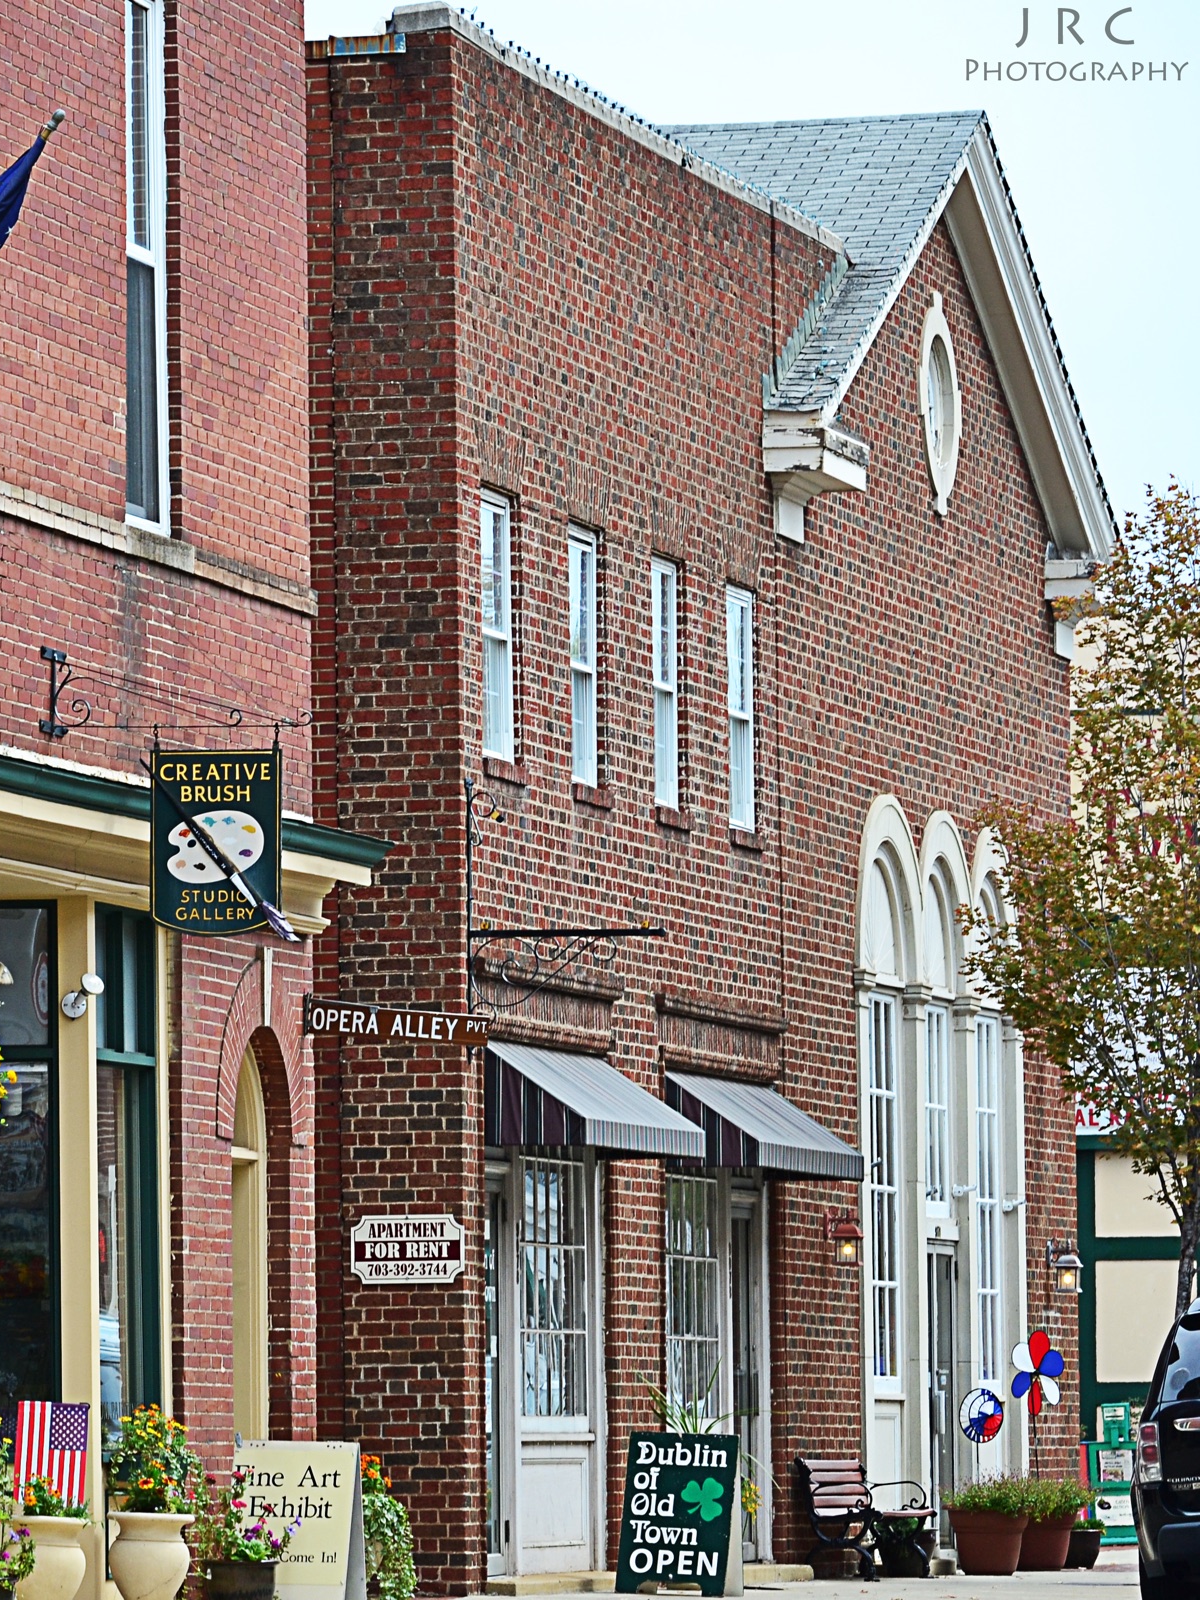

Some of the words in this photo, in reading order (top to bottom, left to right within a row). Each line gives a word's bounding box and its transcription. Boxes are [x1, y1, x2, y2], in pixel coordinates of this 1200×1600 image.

[159, 762, 271, 782] CREATIVE
[179, 784, 251, 803] BRUSH
[180, 889, 249, 904] STUDIO
[175, 906, 255, 922] GALLERY
[311, 1007, 379, 1035] OPERA
[390, 1013, 459, 1041] ALLEY
[368, 1222, 447, 1239] APARTMENT
[364, 1242, 400, 1259] FOR
[405, 1241, 451, 1258] RENT
[367, 1262, 448, 1277] 703-392-3744
[635, 1440, 728, 1468] Dublin
[297, 1464, 341, 1488] Art
[633, 1466, 661, 1490] of
[248, 1495, 333, 1519] Exhibit
[630, 1492, 675, 1517] Old
[629, 1519, 698, 1545] Town
[279, 1551, 315, 1563] Come
[321, 1551, 337, 1564] In!
[629, 1548, 719, 1577] OPEN
